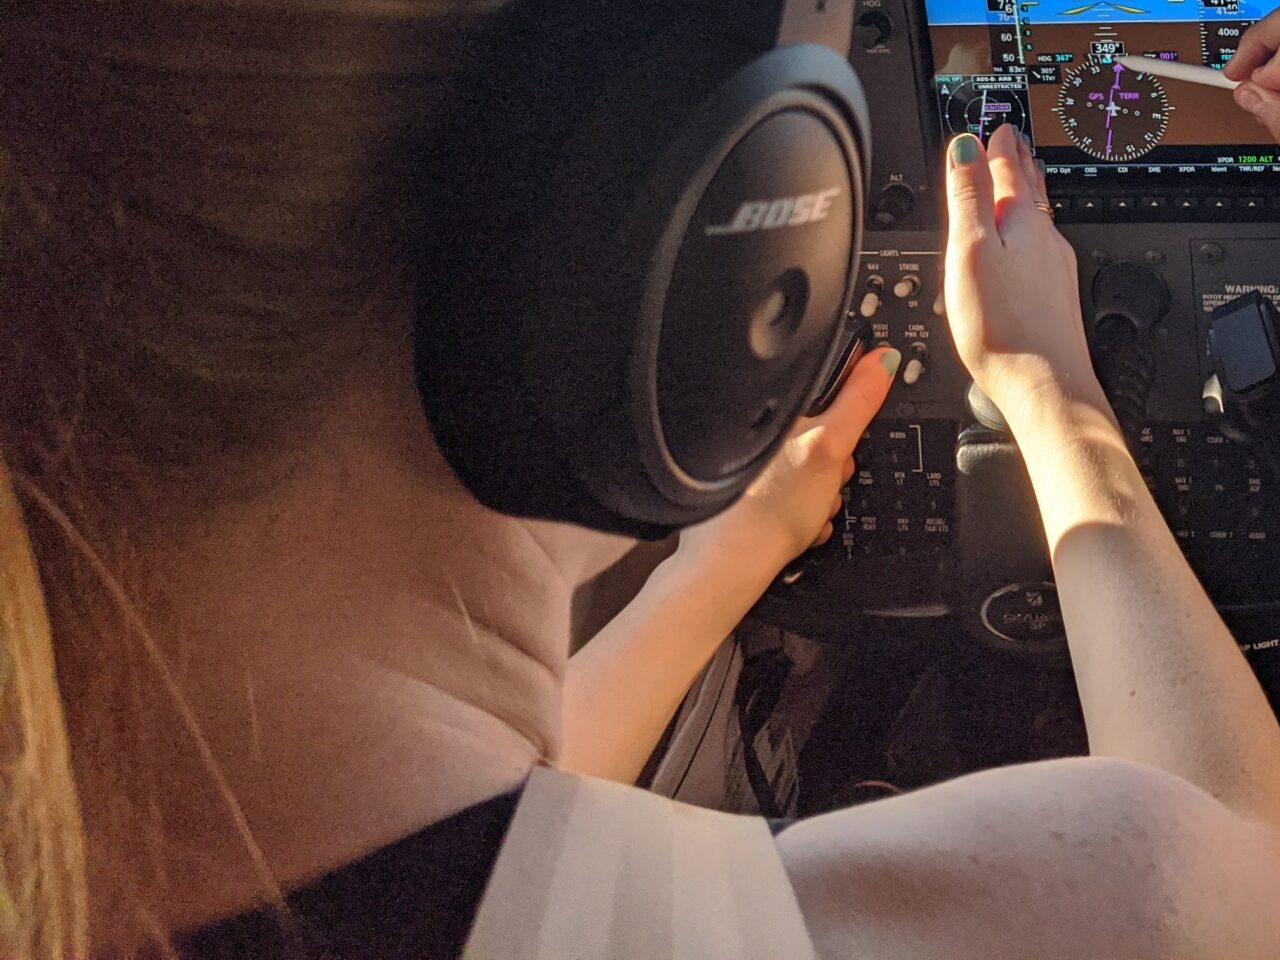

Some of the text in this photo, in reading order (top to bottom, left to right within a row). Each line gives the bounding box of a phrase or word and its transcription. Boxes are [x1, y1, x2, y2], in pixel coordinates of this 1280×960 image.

[862, 0, 881, 8] HDG
[1218, 28, 1240, 36] 4000
[1001, 33, 1012, 41] 60
[1002, 54, 1014, 62] 50
[1088, 92, 1104, 100] GPS
[704, 188, 842, 236] BOSE
[1252, 639, 1280, 650] LIGHT
